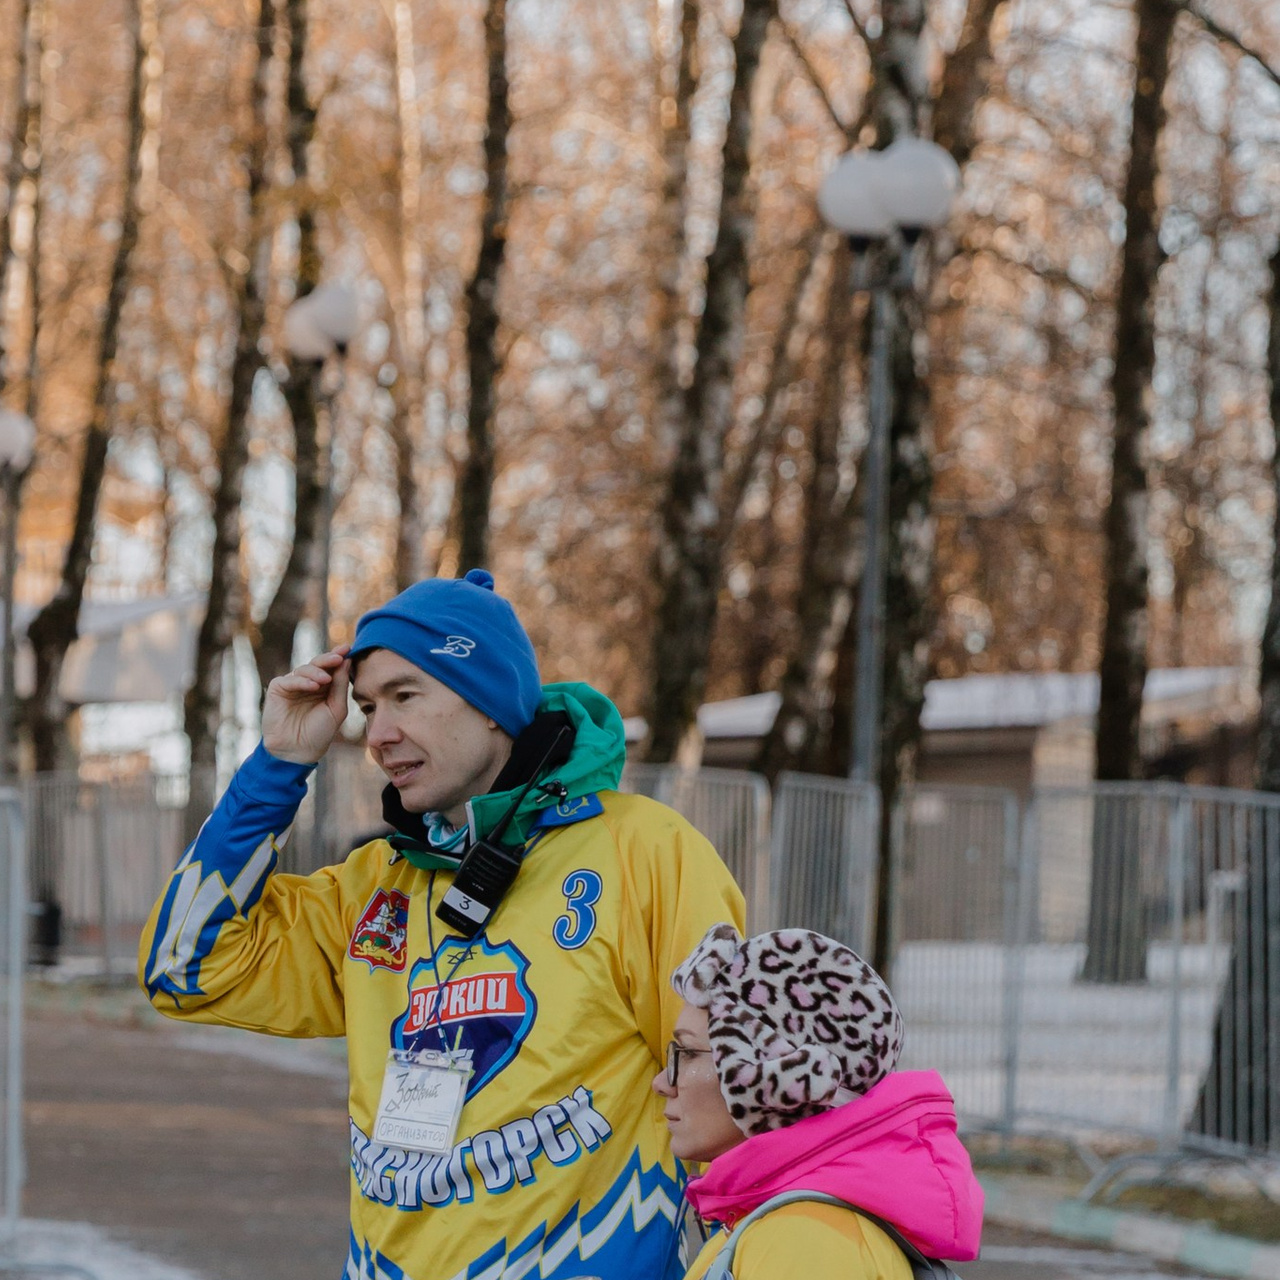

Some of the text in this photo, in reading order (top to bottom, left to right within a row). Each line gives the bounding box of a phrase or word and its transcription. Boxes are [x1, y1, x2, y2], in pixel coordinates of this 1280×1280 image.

[459, 895, 472, 910] 3
[553, 869, 603, 951] 3
[412, 977, 508, 1027] ЗОРКИЙ
[349, 1084, 613, 1211] РАСНОГОРСК
[380, 1122, 446, 1143] ОРГАНИЗАТОР
